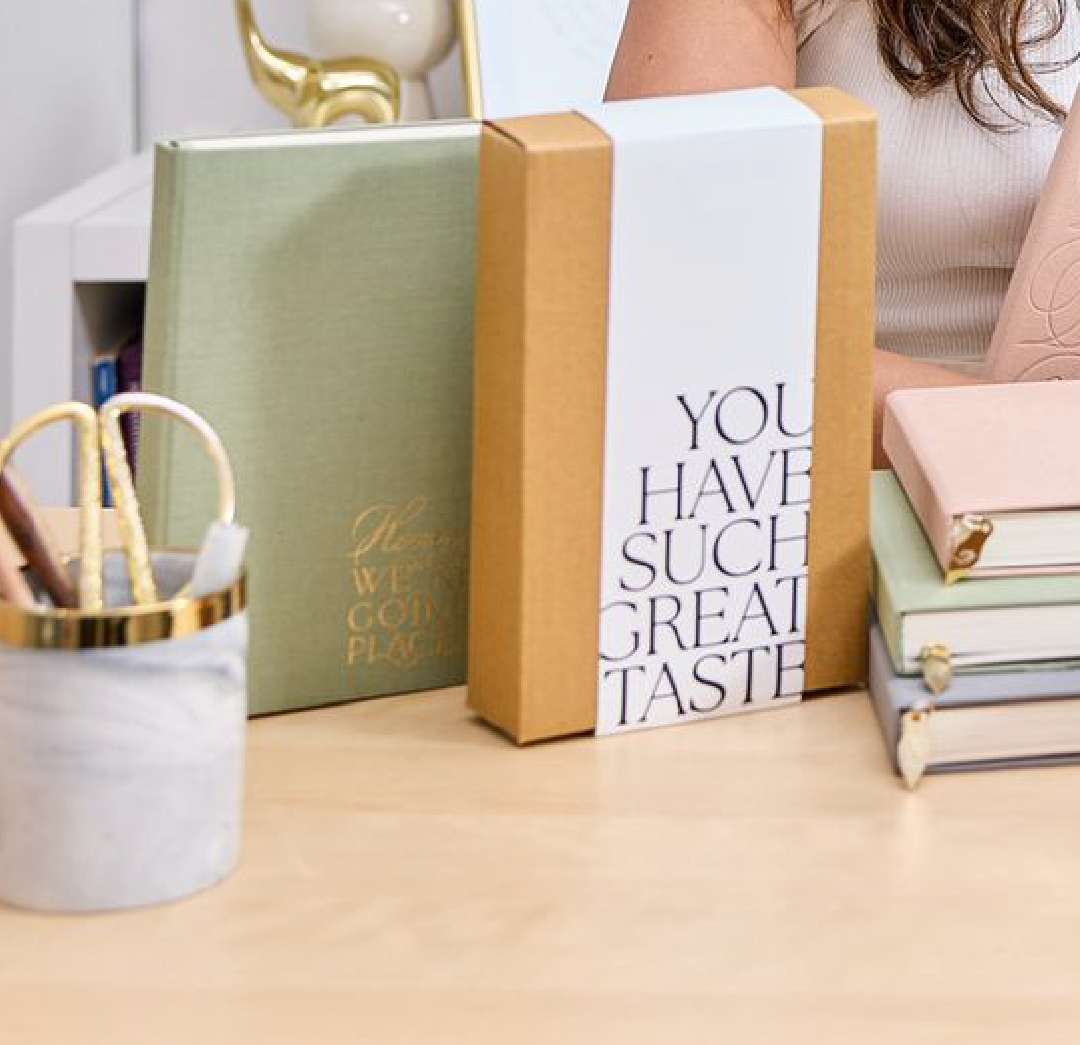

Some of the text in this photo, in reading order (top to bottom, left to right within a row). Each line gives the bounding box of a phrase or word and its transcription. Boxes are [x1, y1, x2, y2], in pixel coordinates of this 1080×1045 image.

[677, 382, 814, 450] YOU
[639, 447, 813, 526] HAVE
[619, 510, 810, 592] SUCH
[599, 574, 808, 662] GREAT
[603, 640, 806, 726] TASTE
